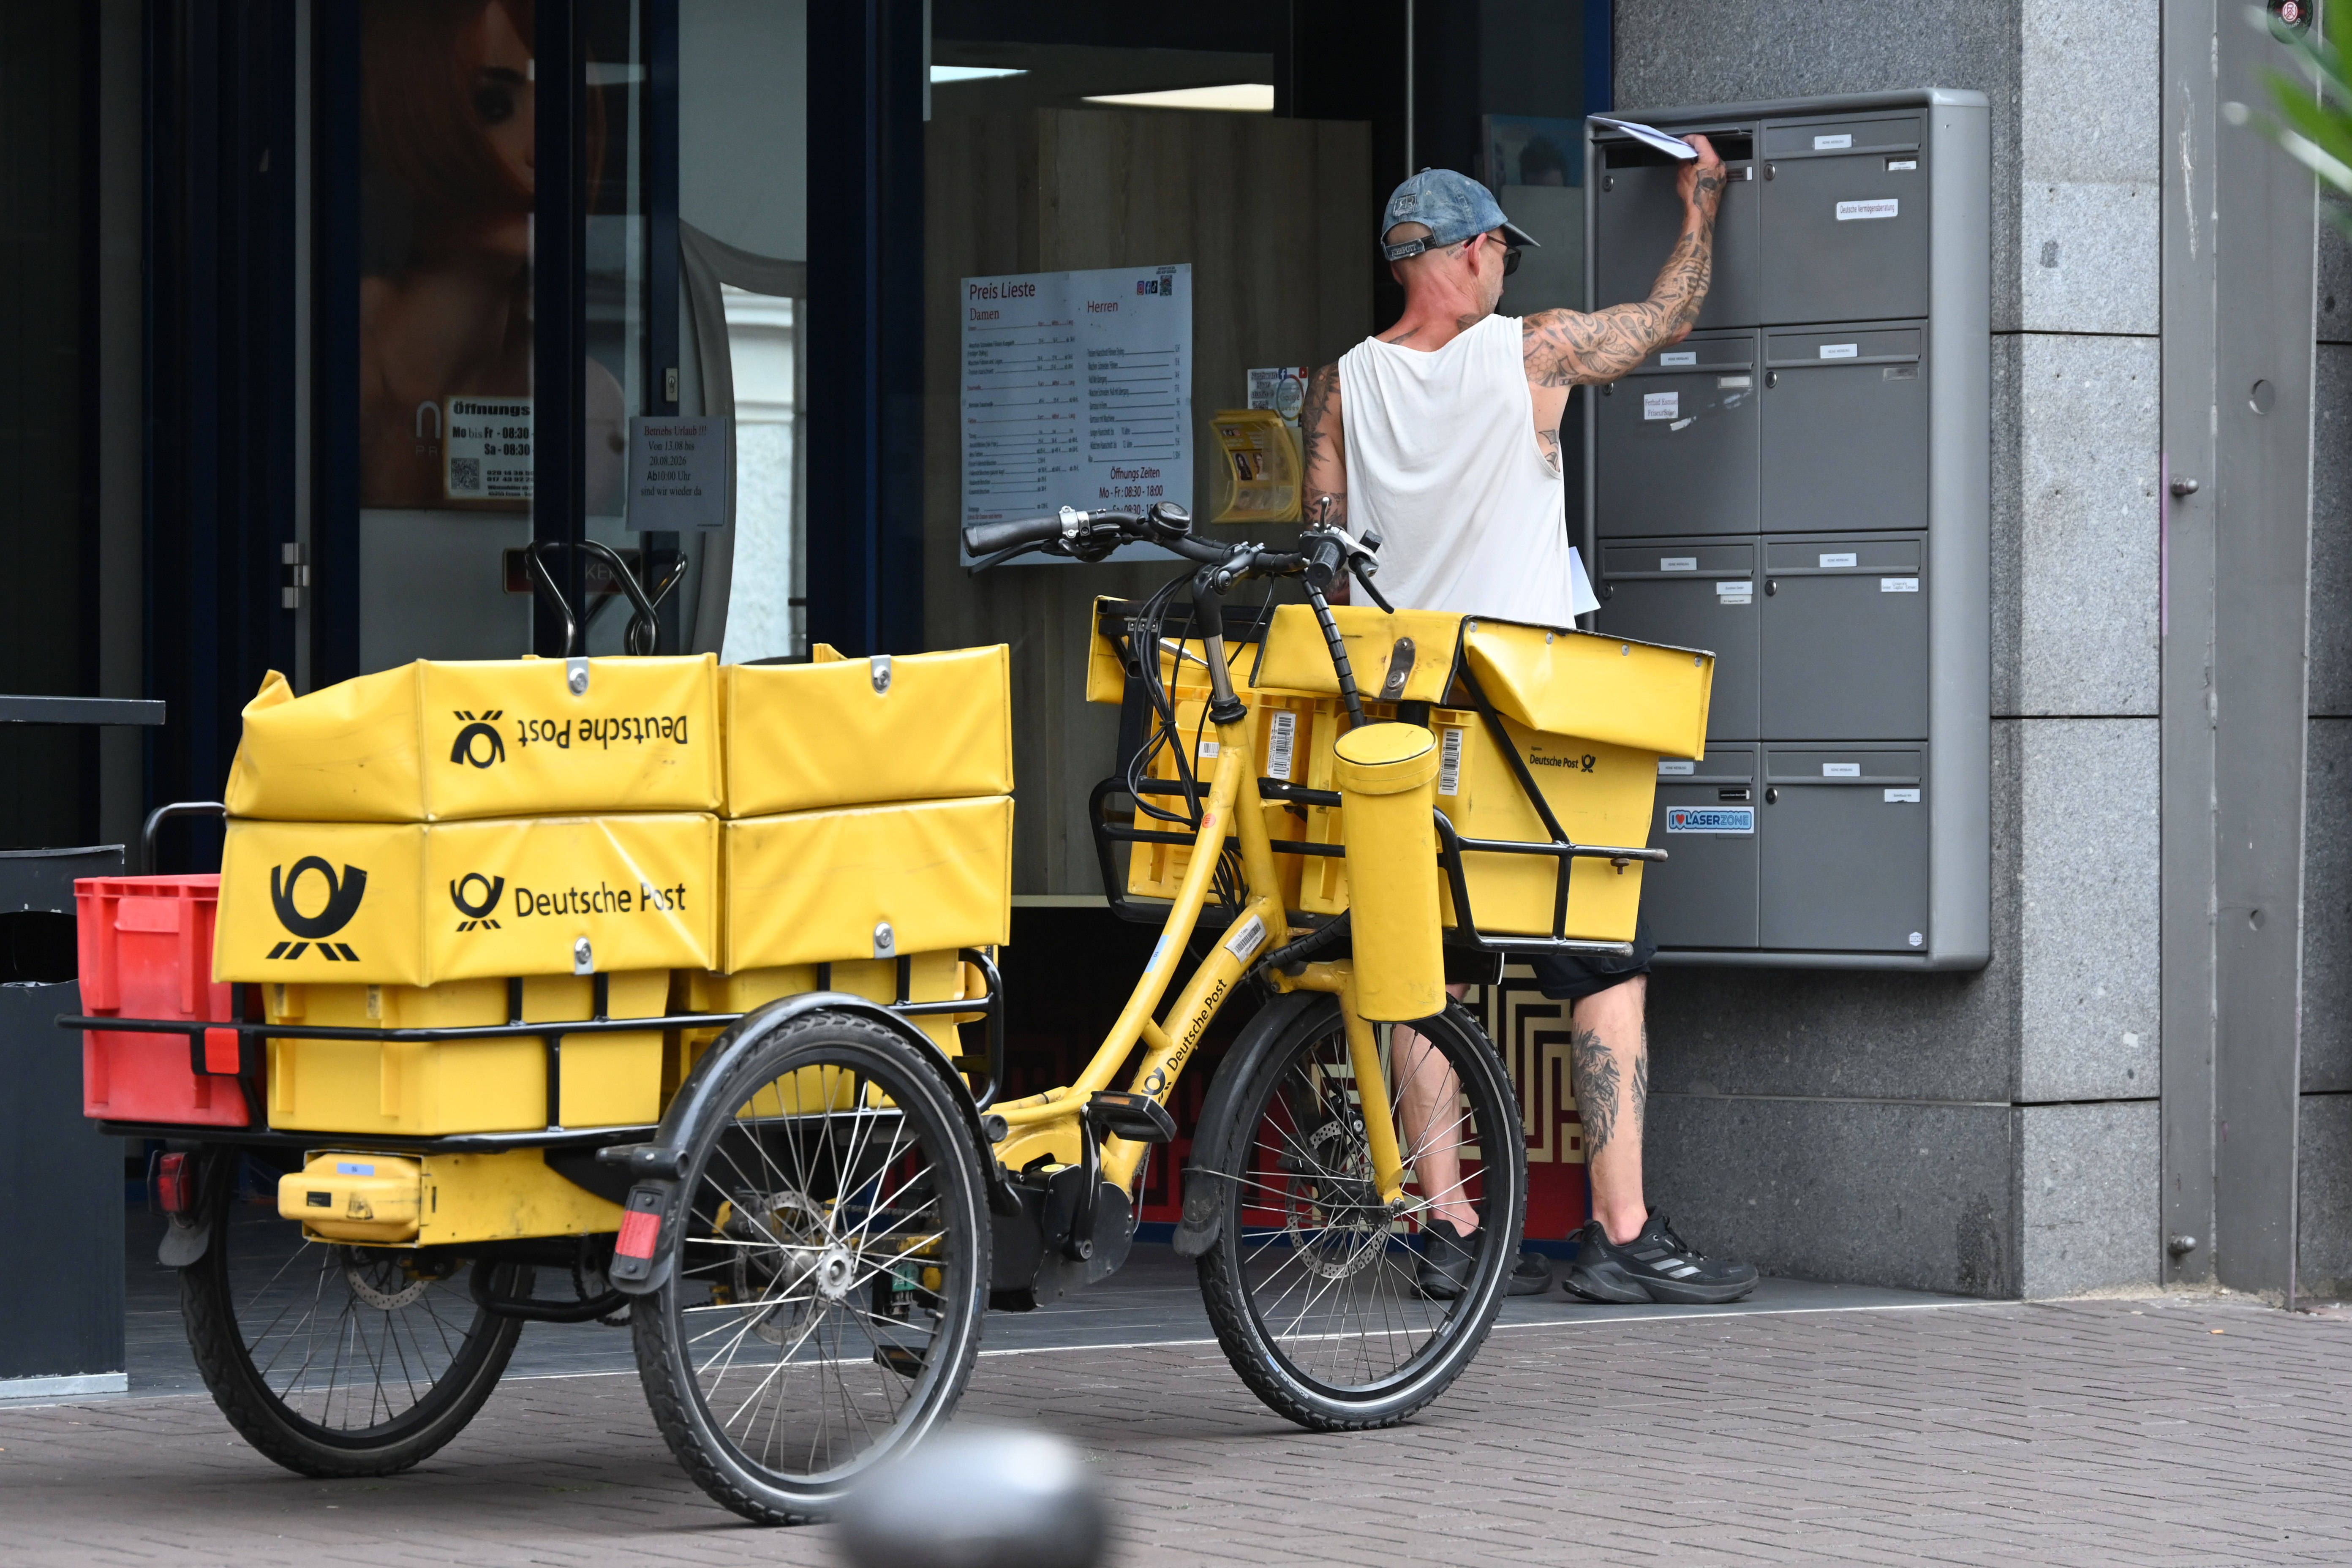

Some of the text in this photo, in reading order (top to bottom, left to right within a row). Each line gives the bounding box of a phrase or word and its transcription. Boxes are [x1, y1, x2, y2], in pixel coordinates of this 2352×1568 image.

[1840, 203, 1895, 214] Deutsche Vermögensberatung
[970, 281, 1035, 300] Preis Lieste
[1087, 301, 1118, 313] Herren
[970, 308, 999, 321] Damen
[453, 400, 530, 416] Öffnungs
[452, 426, 466, 438] Mo
[469, 427, 482, 438] bis
[485, 427, 493, 438] Fr
[502, 427, 529, 439] 08:30
[644, 426, 672, 436] Betriebs
[674, 426, 697, 436] Urlaub
[485, 443, 496, 455] Sa
[503, 443, 530, 456] 08:30
[648, 441, 694, 451] Von 13.08 bis
[649, 456, 686, 466] 20.08.2026
[678, 471, 691, 480] Uhr
[1111, 466, 1160, 481] Öffnungs Zeiten
[641, 486, 702, 496] sind wir wieder da
[1099, 487, 1109, 498] Mo
[1114, 486, 1120, 497] Fr
[1124, 486, 1141, 497] 08:30
[1147, 485, 1163, 496] 18:00
[517, 716, 688, 750] Deutsche Post
[1530, 754, 1579, 768] Deutsche Post
[1685, 814, 1749, 825] LASERZONE
[515, 882, 686, 917] Deutsche Post
[1166, 978, 1227, 1072] Deutsche Post
[1279, 1371, 1310, 1400] SCHWALBE
